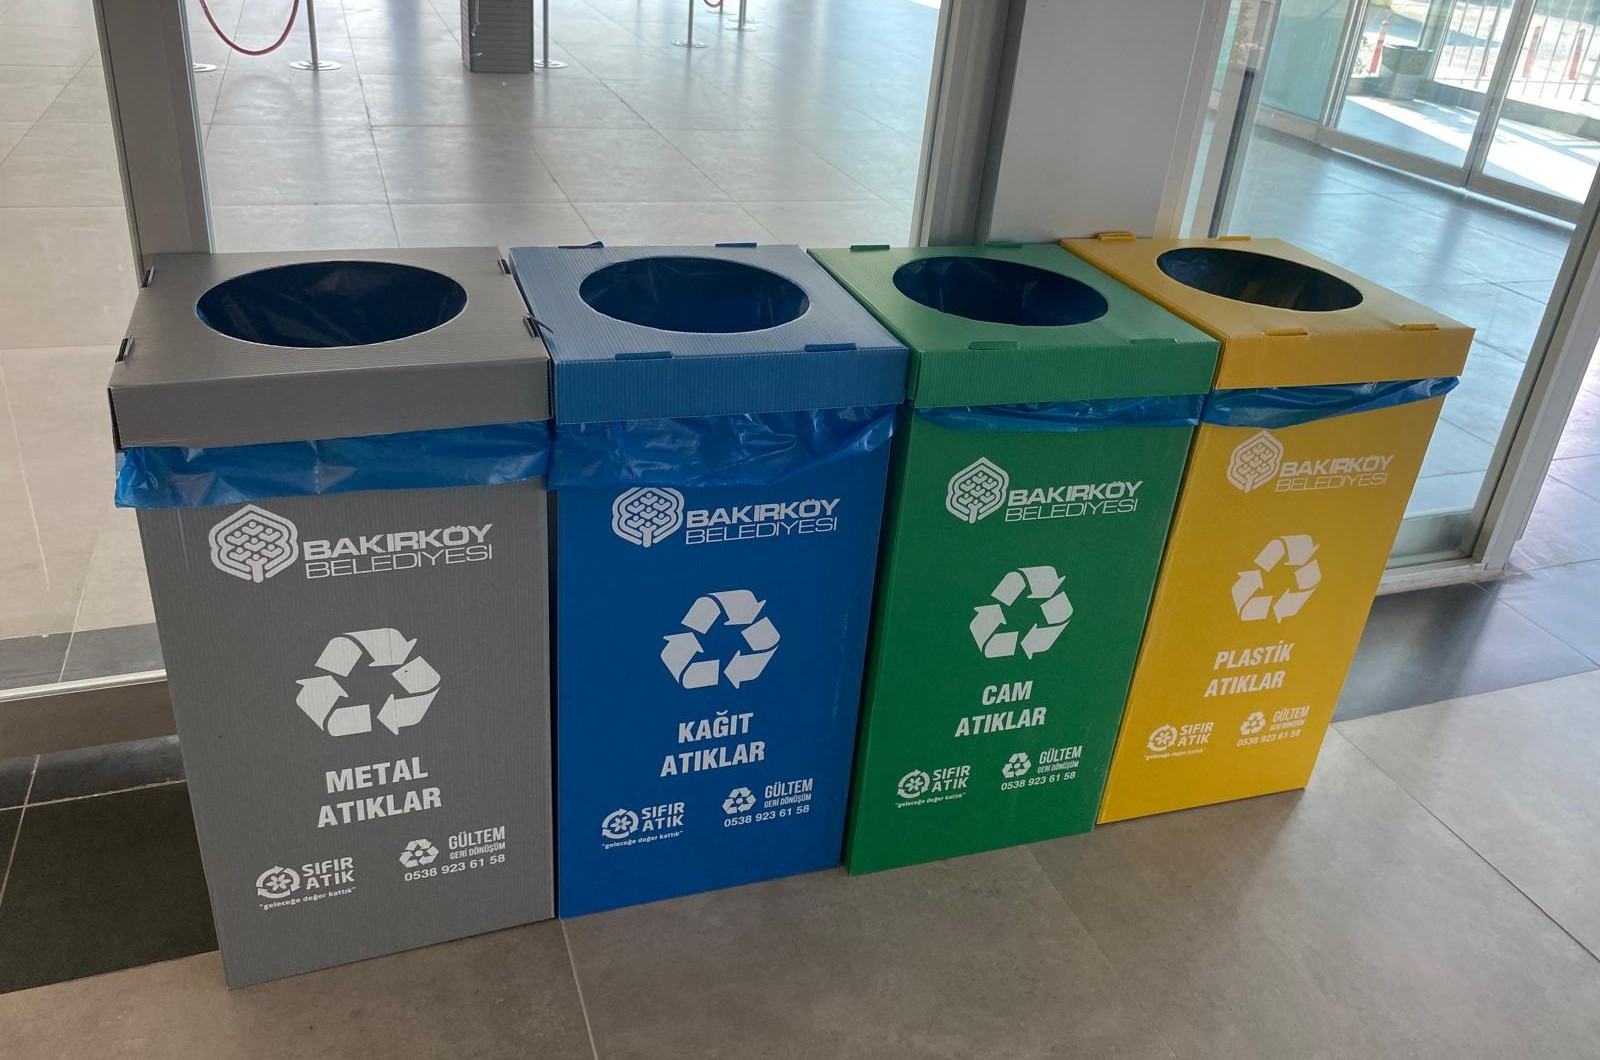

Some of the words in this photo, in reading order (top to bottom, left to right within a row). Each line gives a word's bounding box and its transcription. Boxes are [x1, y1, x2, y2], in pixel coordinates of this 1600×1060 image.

[686, 499, 840, 528] BAKIRKÖY
[303, 524, 493, 561] BAKIRKÖY
[1213, 640, 1294, 670] PLASTİK
[982, 680, 1033, 706] CAM
[1203, 670, 1285, 698] ATIKLAR
[678, 709, 753, 743] KAĞIT
[954, 706, 1047, 737] ATIKLAR
[1180, 722, 1214, 735] SIFIR
[1177, 733, 1210, 747] ATIK
[660, 741, 765, 777] ATIKLAR
[1039, 746, 1082, 764] GÜLTEM
[325, 756, 428, 793] METAL
[933, 765, 971, 780] SIFIR
[1001, 780, 1025, 790] 0538
[1028, 776, 1046, 786] 923
[1049, 774, 1060, 782] 61
[1063, 771, 1076, 780] 58
[764, 778, 813, 798] GÜLTEM
[931, 777, 969, 792] ATIK
[317, 787, 442, 828] ATIKLAR
[641, 801, 685, 819] SIFIR
[724, 815, 752, 827] 0538
[755, 811, 776, 821] 923
[779, 808, 792, 817] 61
[796, 804, 810, 814] 58
[642, 814, 684, 832] ATIK
[448, 826, 505, 849] GÜLTEM
[449, 848, 467, 860] GERİ
[468, 842, 505, 857] DÖNÜŞÜM
[301, 857, 354, 876] SIFIR
[404, 867, 437, 881] 0538
[441, 862, 465, 874] 923
[469, 858, 484, 868] 61
[489, 854, 505, 864] 58
[306, 870, 355, 890] ATIK
